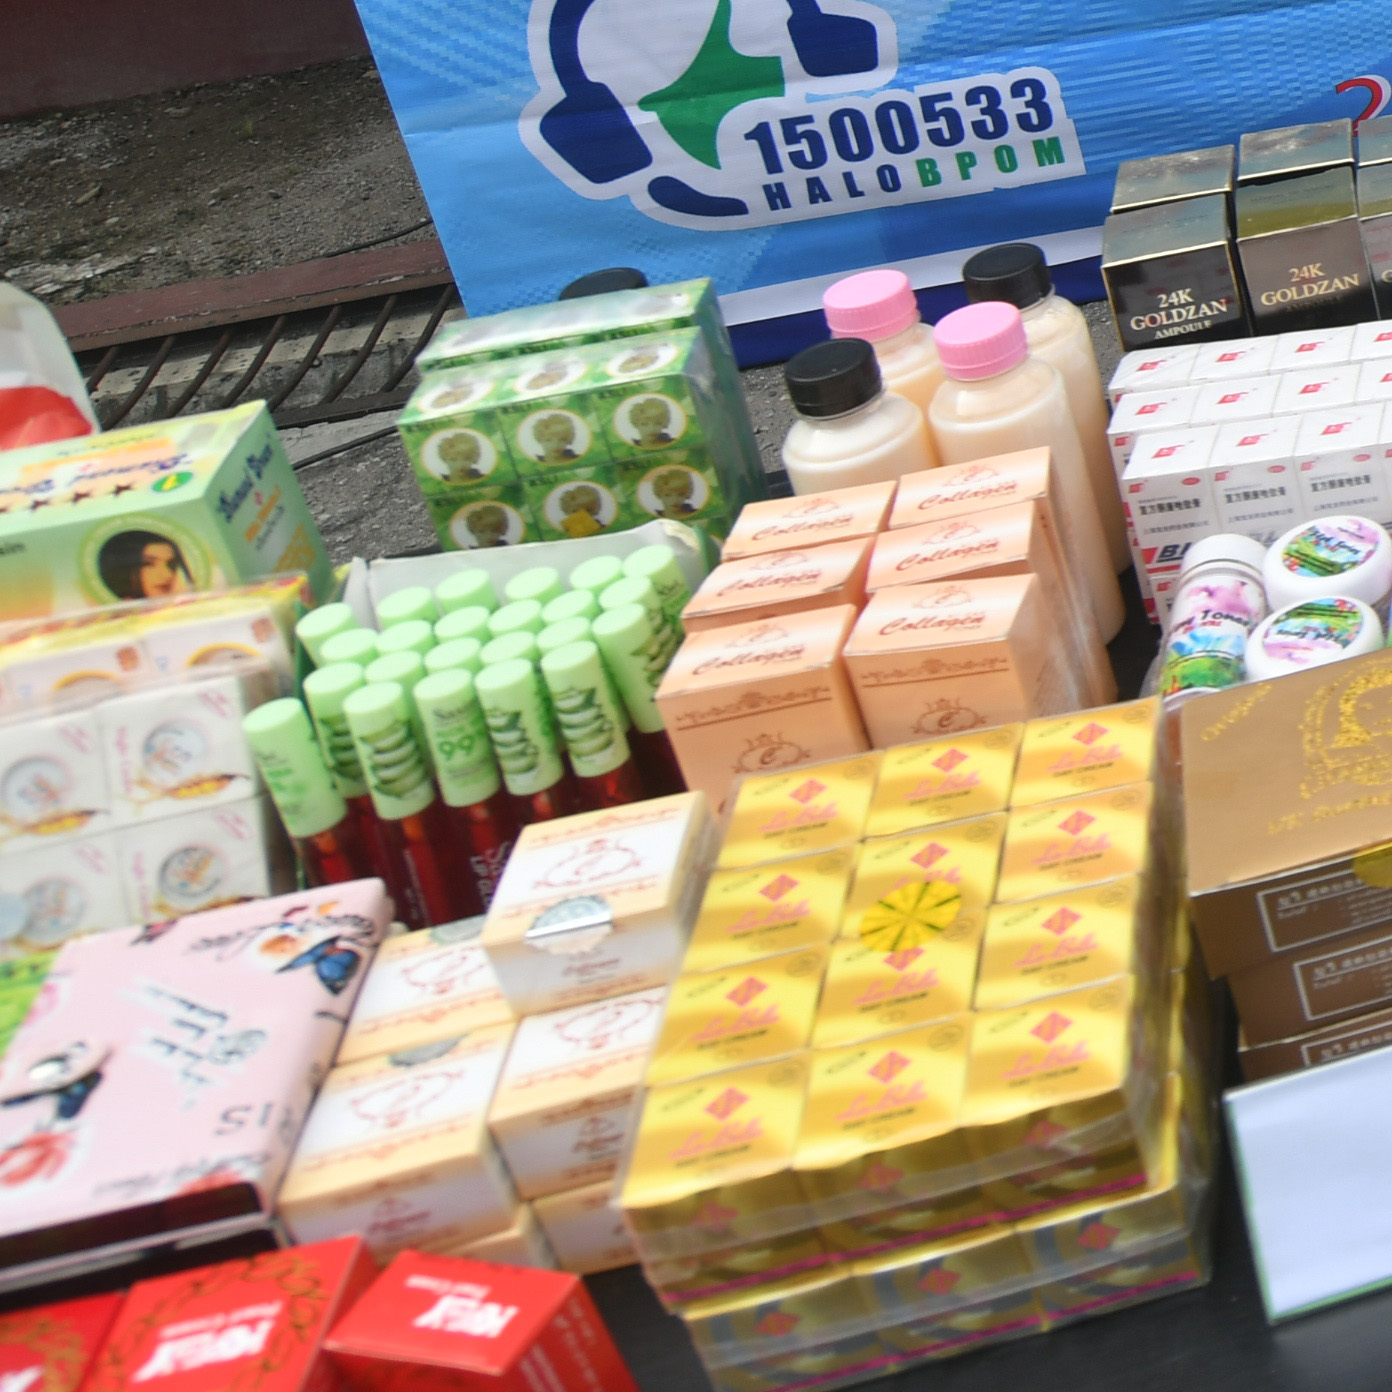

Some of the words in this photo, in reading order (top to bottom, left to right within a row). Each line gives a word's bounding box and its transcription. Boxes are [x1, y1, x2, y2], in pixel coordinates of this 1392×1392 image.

[743, 78, 1054, 175] 1500533
[1289, 263, 1326, 282] 24K
[1157, 289, 1194, 309] 24K
[1261, 273, 1361, 307] GOLDZAN
[1131, 299, 1230, 331] GOLDZAN
[1154, 319, 1213, 341] AMPOULE
[918, 481, 1018, 510] Collagen
[752, 516, 854, 541] Collagen
[896, 539, 999, 572] Collagen
[716, 569, 822, 597] Collagen
[879, 614, 985, 642] Collagen
[692, 644, 805, 676] Collagen
